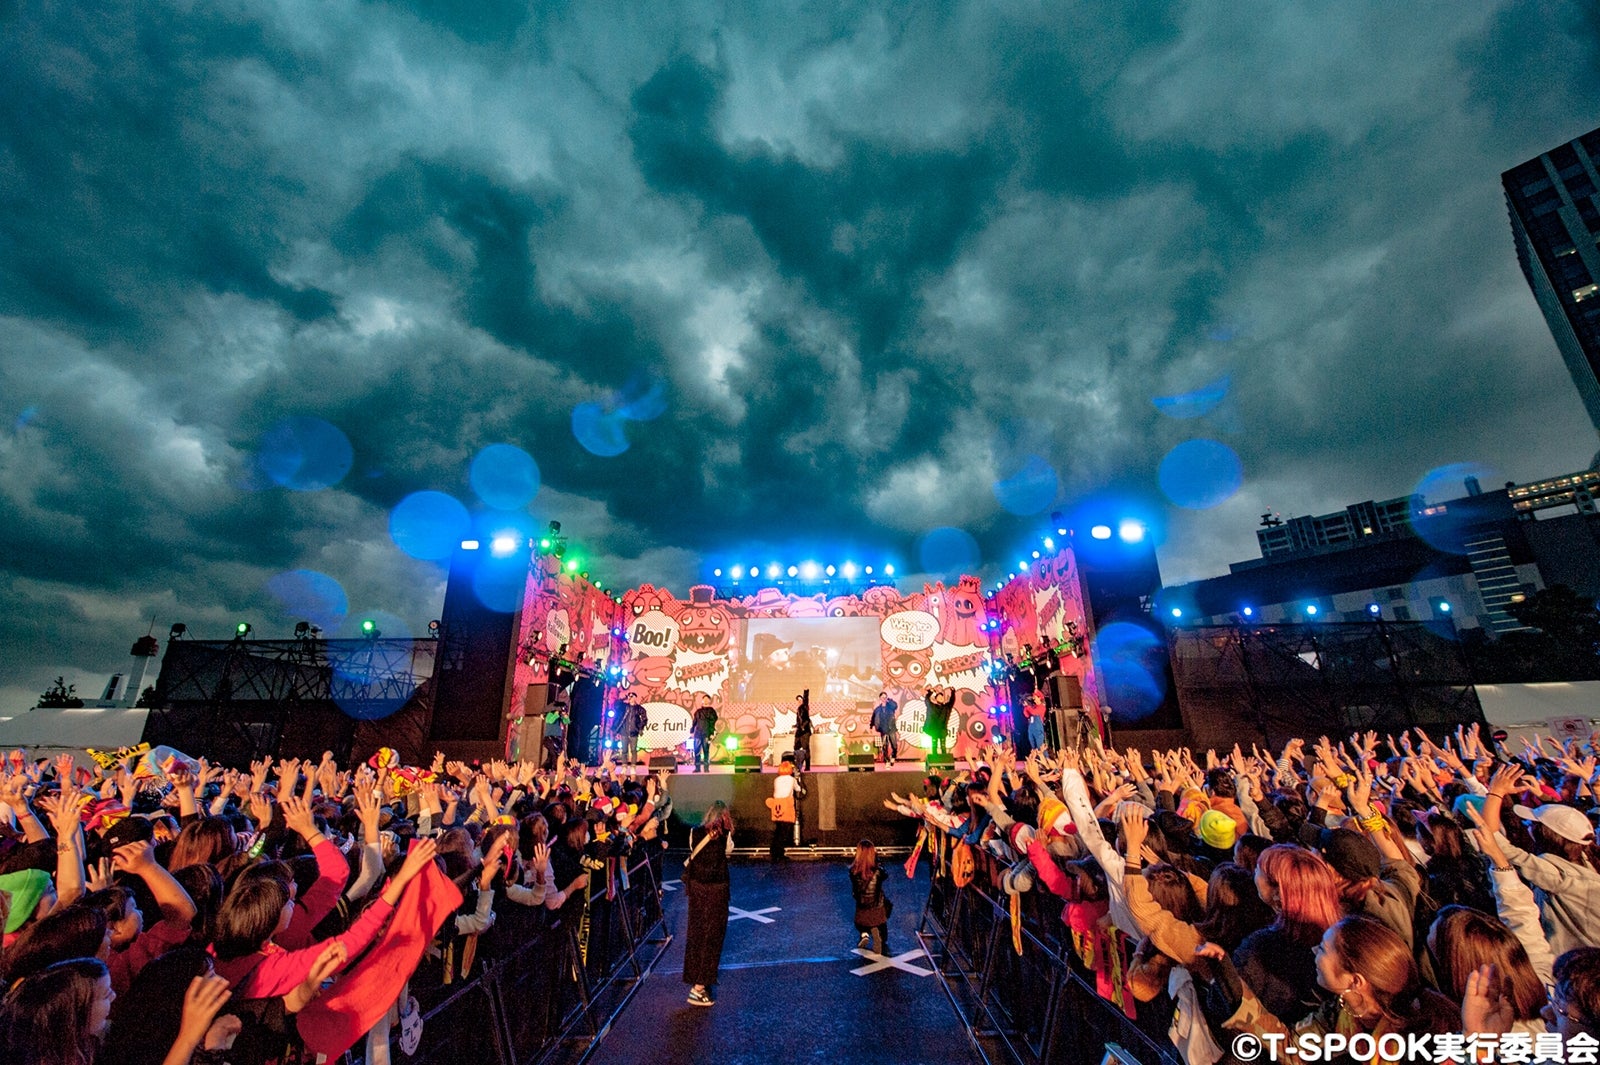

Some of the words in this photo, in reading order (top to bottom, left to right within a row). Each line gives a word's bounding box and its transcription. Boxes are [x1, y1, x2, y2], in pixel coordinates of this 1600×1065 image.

[890, 618, 914, 633] Way
[915, 620, 932, 632] too
[633, 623, 672, 648] Boo!
[896, 634, 924, 645] cute!
[663, 718, 687, 732] fun!
